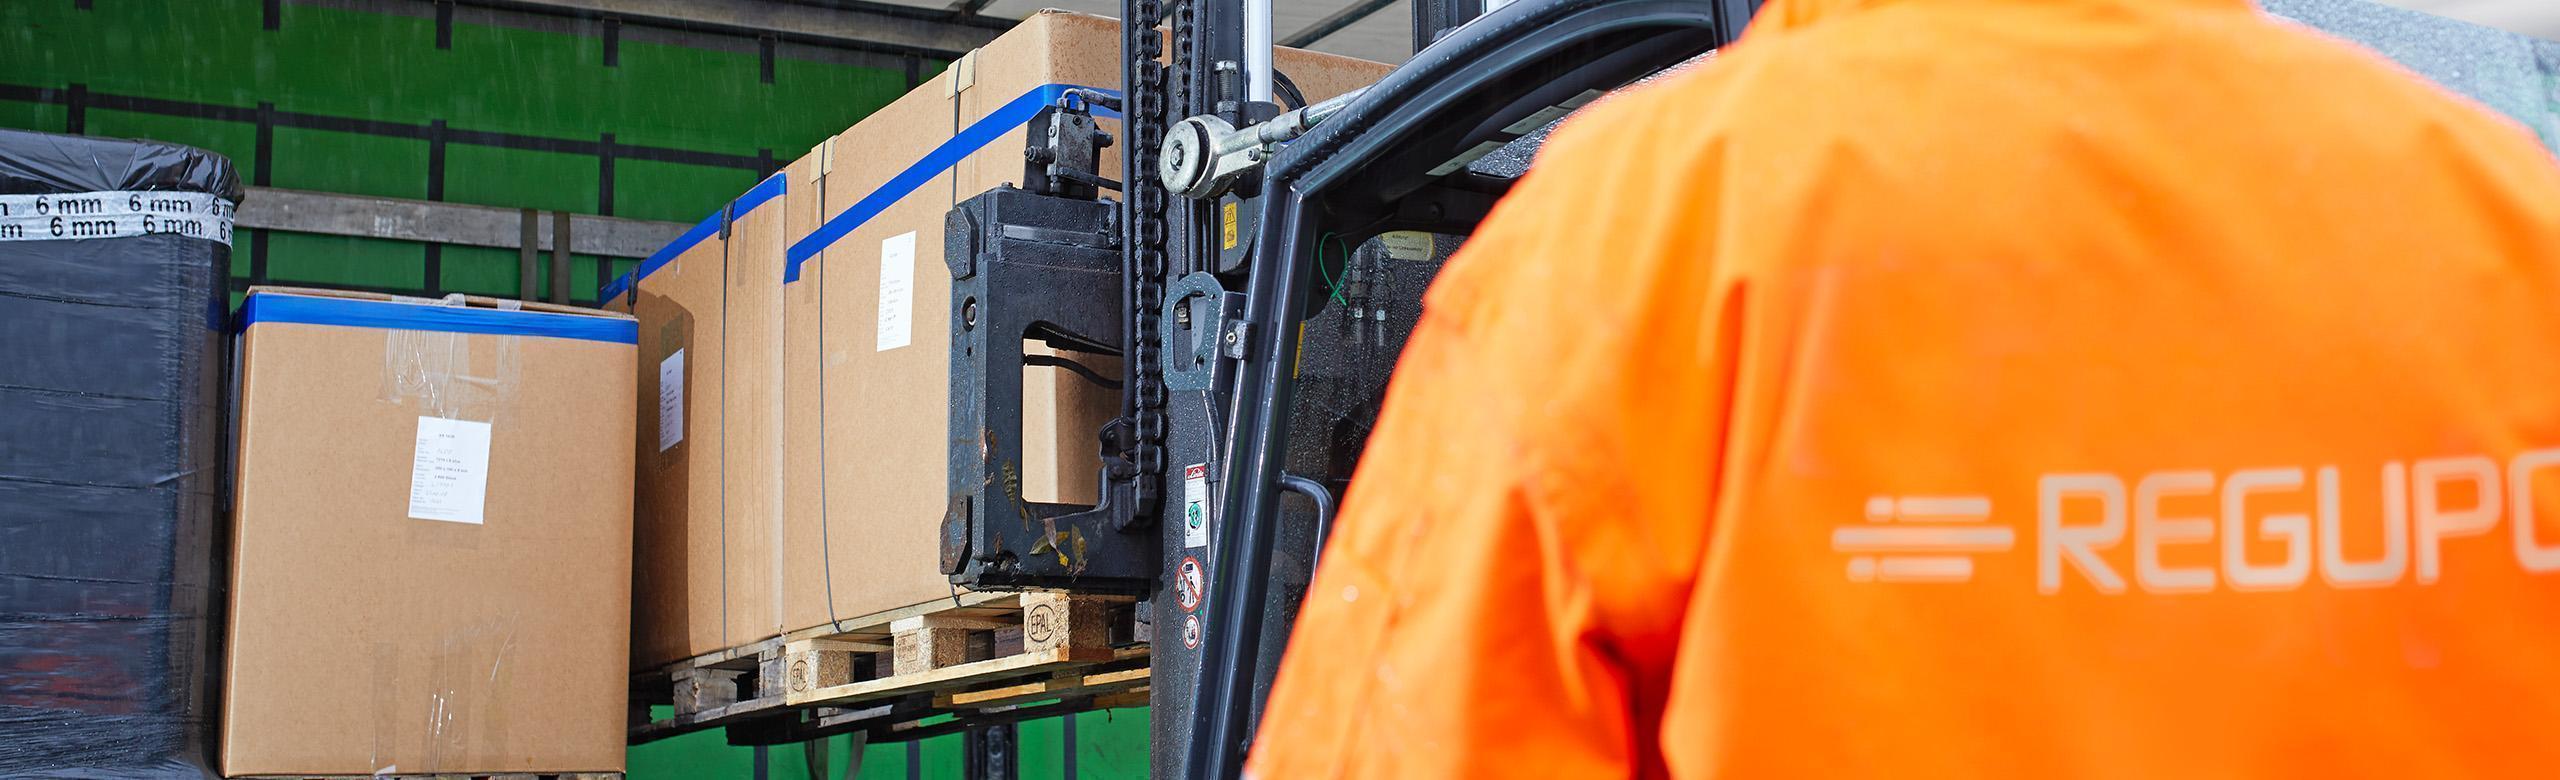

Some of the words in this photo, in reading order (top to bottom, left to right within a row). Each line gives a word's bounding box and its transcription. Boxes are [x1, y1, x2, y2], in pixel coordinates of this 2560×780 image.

[36, 196, 49, 215] 6
[58, 198, 102, 214] mm
[129, 194, 141, 212] 6
[150, 199, 191, 213] mm
[212, 197, 220, 216] 6
[50, 216, 63, 237] 6
[73, 220, 116, 236] mm
[143, 214, 155, 234] 6
[164, 219, 202, 235] mm
[220, 221, 226, 240] 6
[1031, 612, 1052, 635] EPAL
